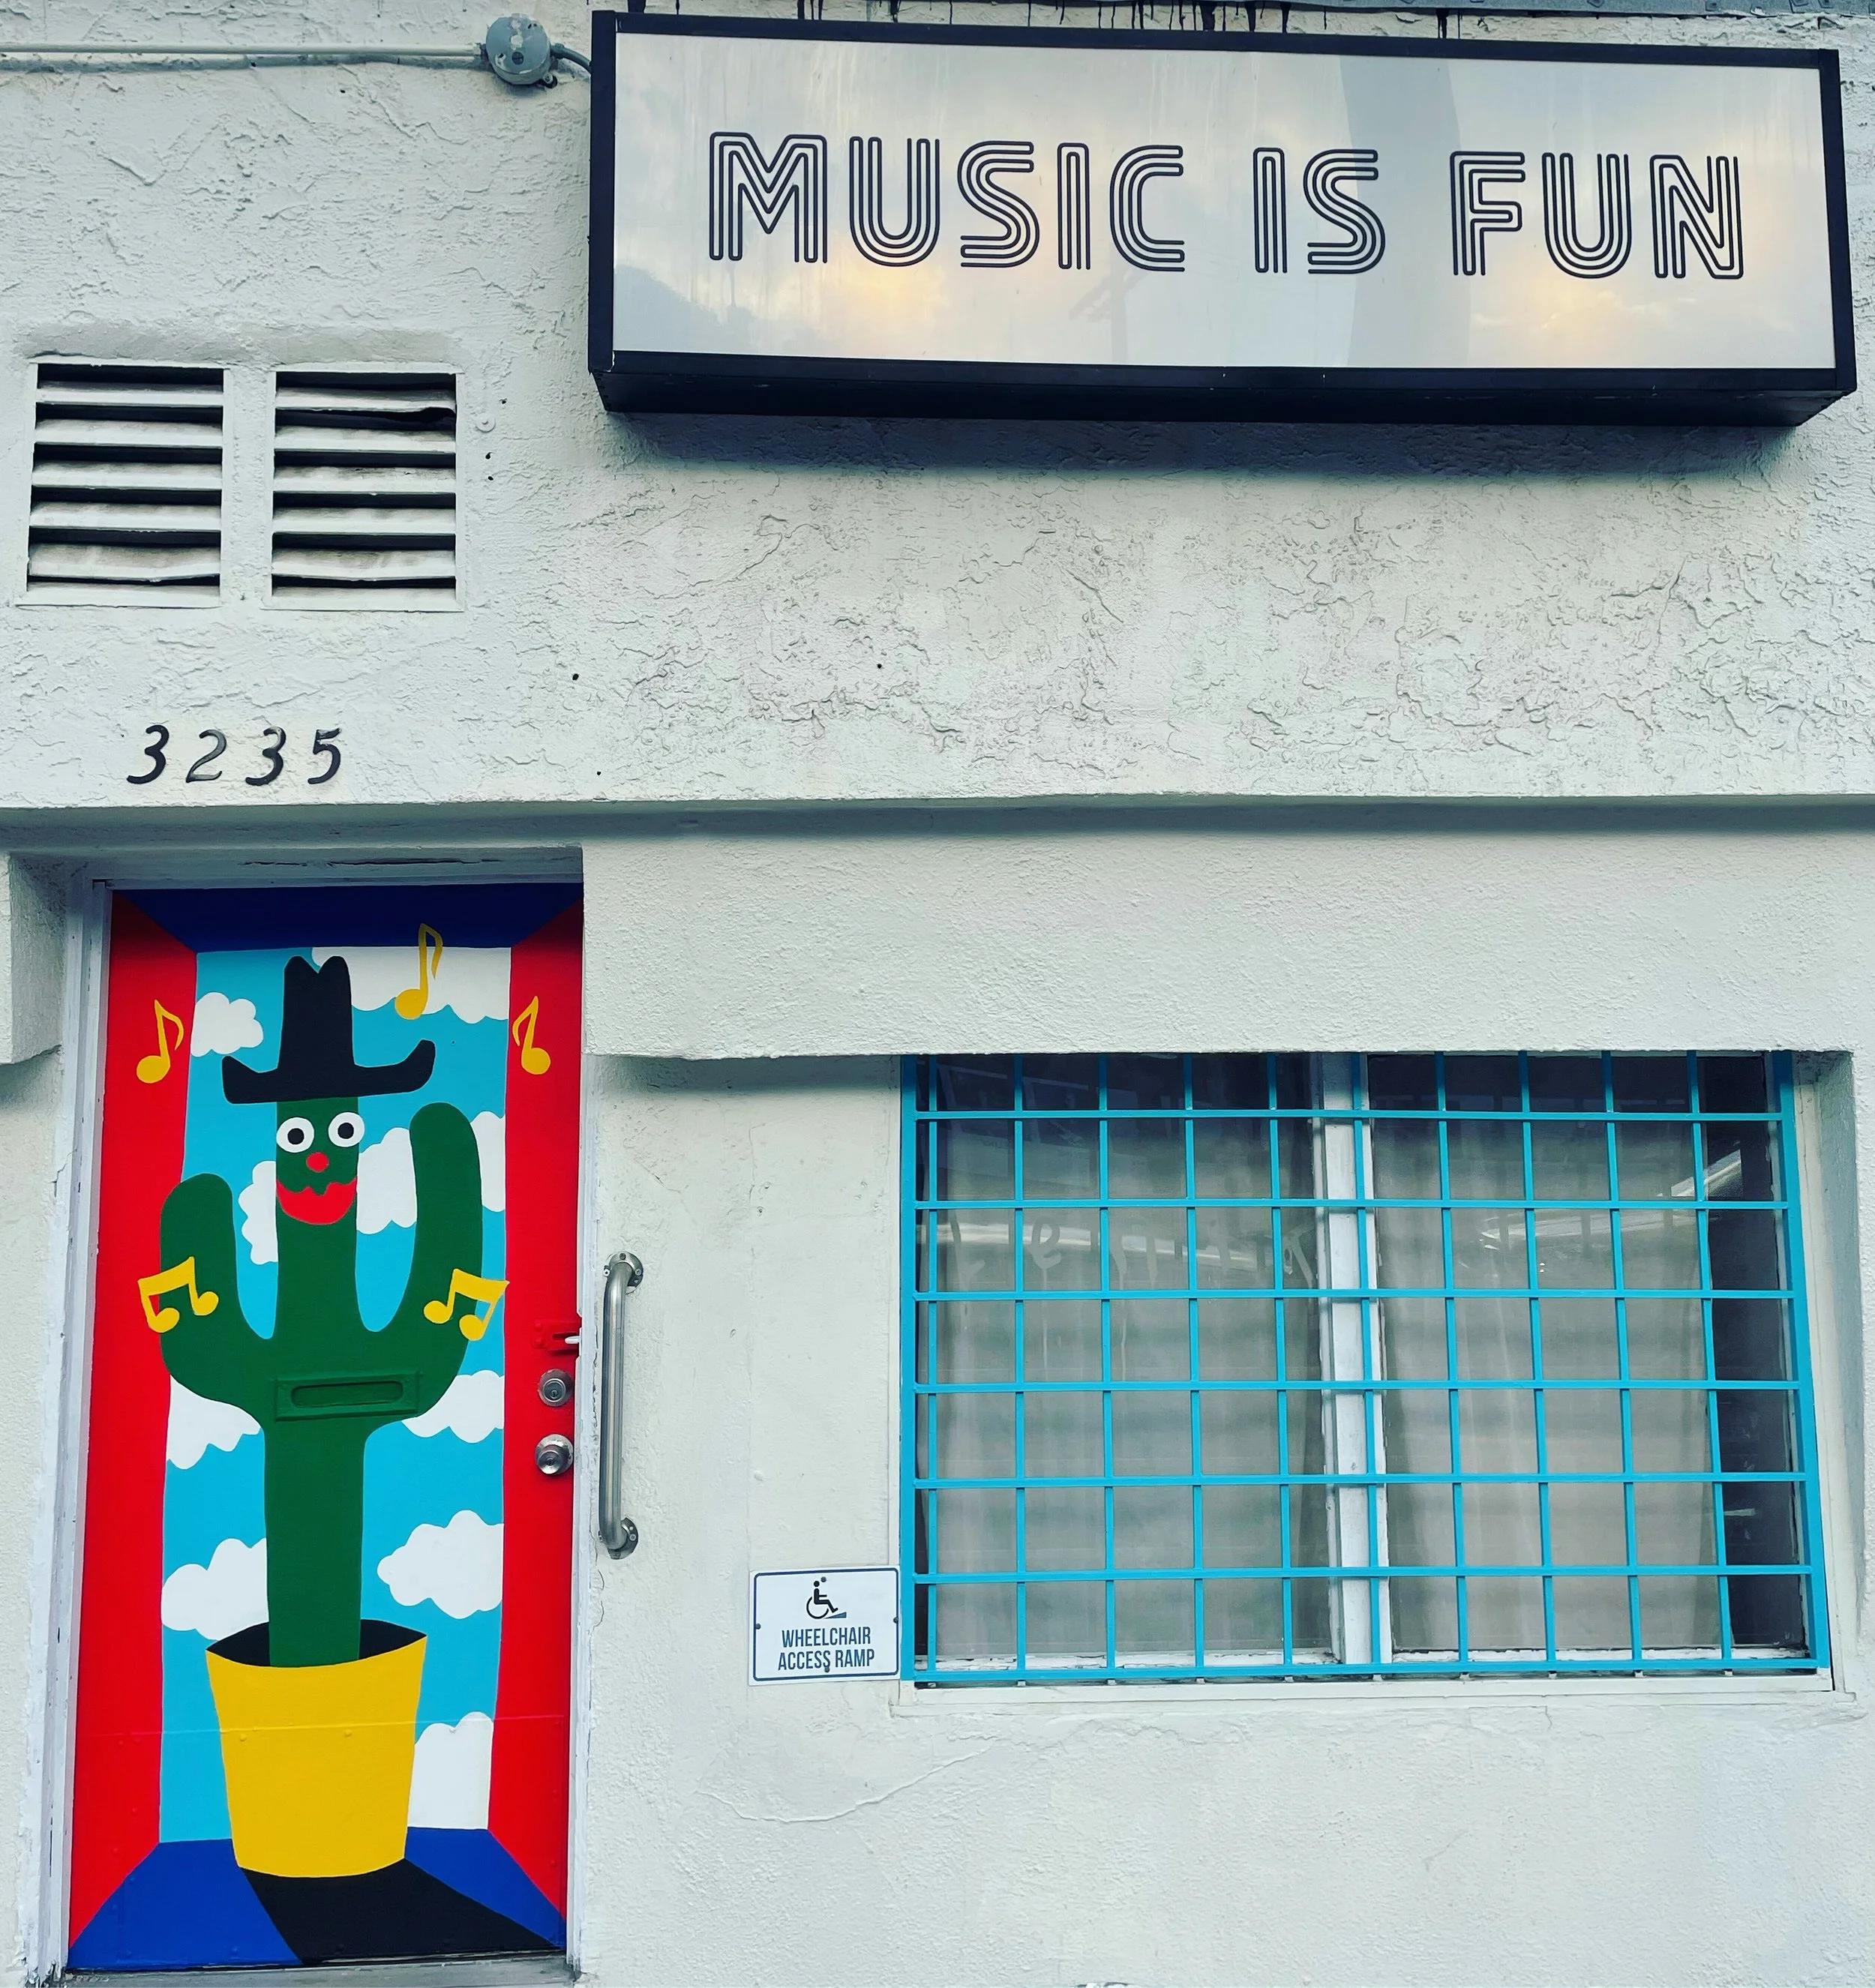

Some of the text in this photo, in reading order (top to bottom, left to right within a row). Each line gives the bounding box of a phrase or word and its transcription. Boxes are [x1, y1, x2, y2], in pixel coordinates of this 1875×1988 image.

[710, 132, 1743, 279] MUSIC IS FUN
[126, 724, 341, 786] 3235
[782, 1627, 871, 1648] WHEELCHAIR
[778, 1648, 874, 1671] ACCESS RAMP
